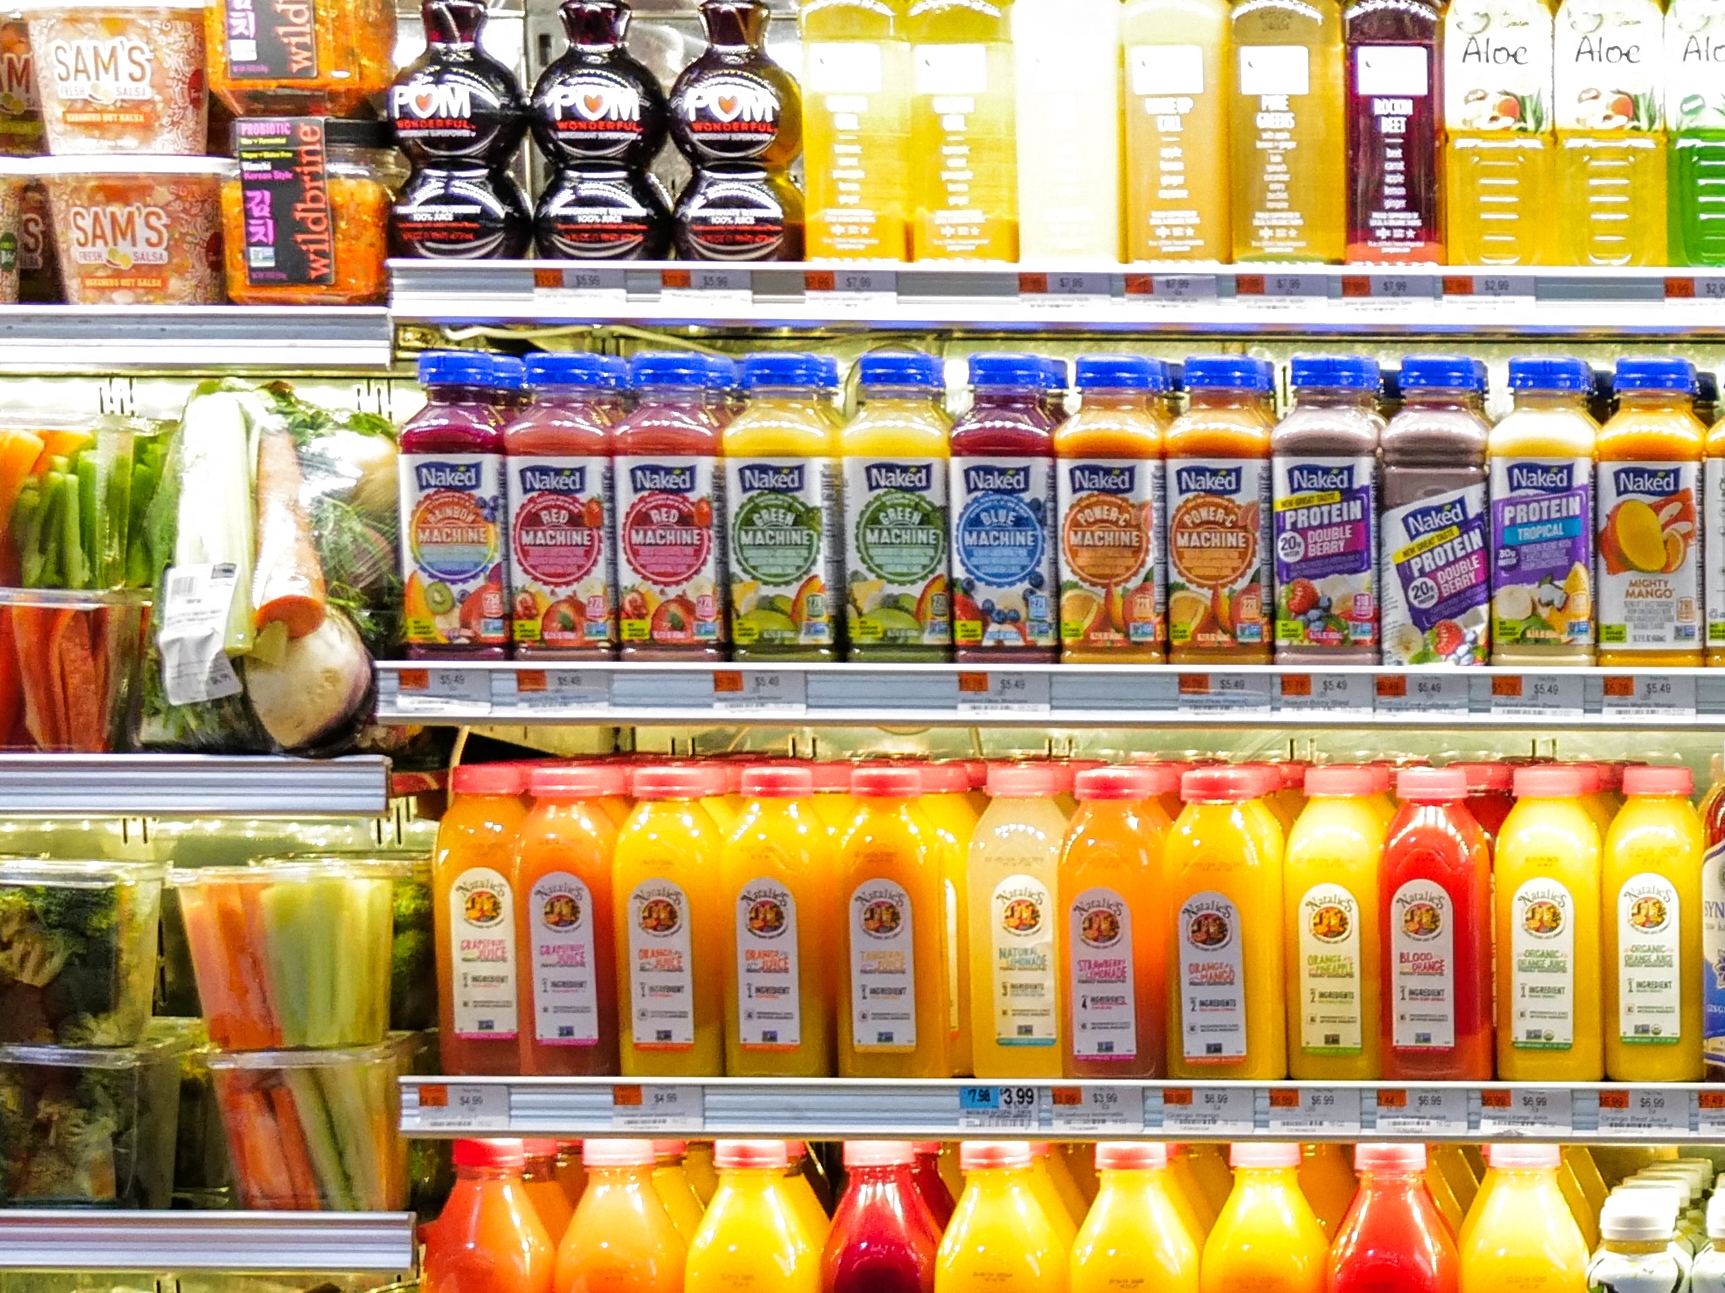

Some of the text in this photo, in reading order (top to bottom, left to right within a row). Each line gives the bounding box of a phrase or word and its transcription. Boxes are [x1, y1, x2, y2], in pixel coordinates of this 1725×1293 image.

[1463, 36, 1529, 65] Aloe
[1576, 36, 1641, 65] Aloe
[56, 44, 147, 82] SAM'S
[294, 125, 333, 280] wildbrine
[71, 208, 165, 247] SAM'S
[421, 468, 476, 487] Naked
[526, 471, 581, 490] Naked
[636, 470, 690, 489] Naked
[745, 469, 799, 488] Naked
[870, 470, 927, 488] Naked
[1075, 470, 1130, 490] Naked
[1293, 469, 1348, 489] Naked
[1511, 468, 1568, 487] Naked
[1619, 471, 1674, 491] Naked
[540, 511, 568, 524] RED
[651, 511, 678, 523] RED
[753, 511, 795, 527] GREEN
[980, 511, 1016, 526] BLUE
[1285, 501, 1362, 529] PROTEIN
[1504, 497, 1580, 525] PROTEIN
[418, 528, 487, 543] MACHINE
[522, 530, 591, 546] MACHINE
[631, 529, 701, 545] MACHINE
[741, 530, 811, 545] MACHINE
[964, 531, 1036, 546] MACHINE
[1070, 531, 1140, 547] MACHINE
[1307, 525, 1352, 543] DOUBLE
[1517, 522, 1565, 538] TROPICAL
[1308, 540, 1346, 557] BERRY
[1411, 528, 1483, 578] PROTEIN
[1629, 579, 1670, 589] MIGHTY
[1625, 589, 1673, 599] MANGO
